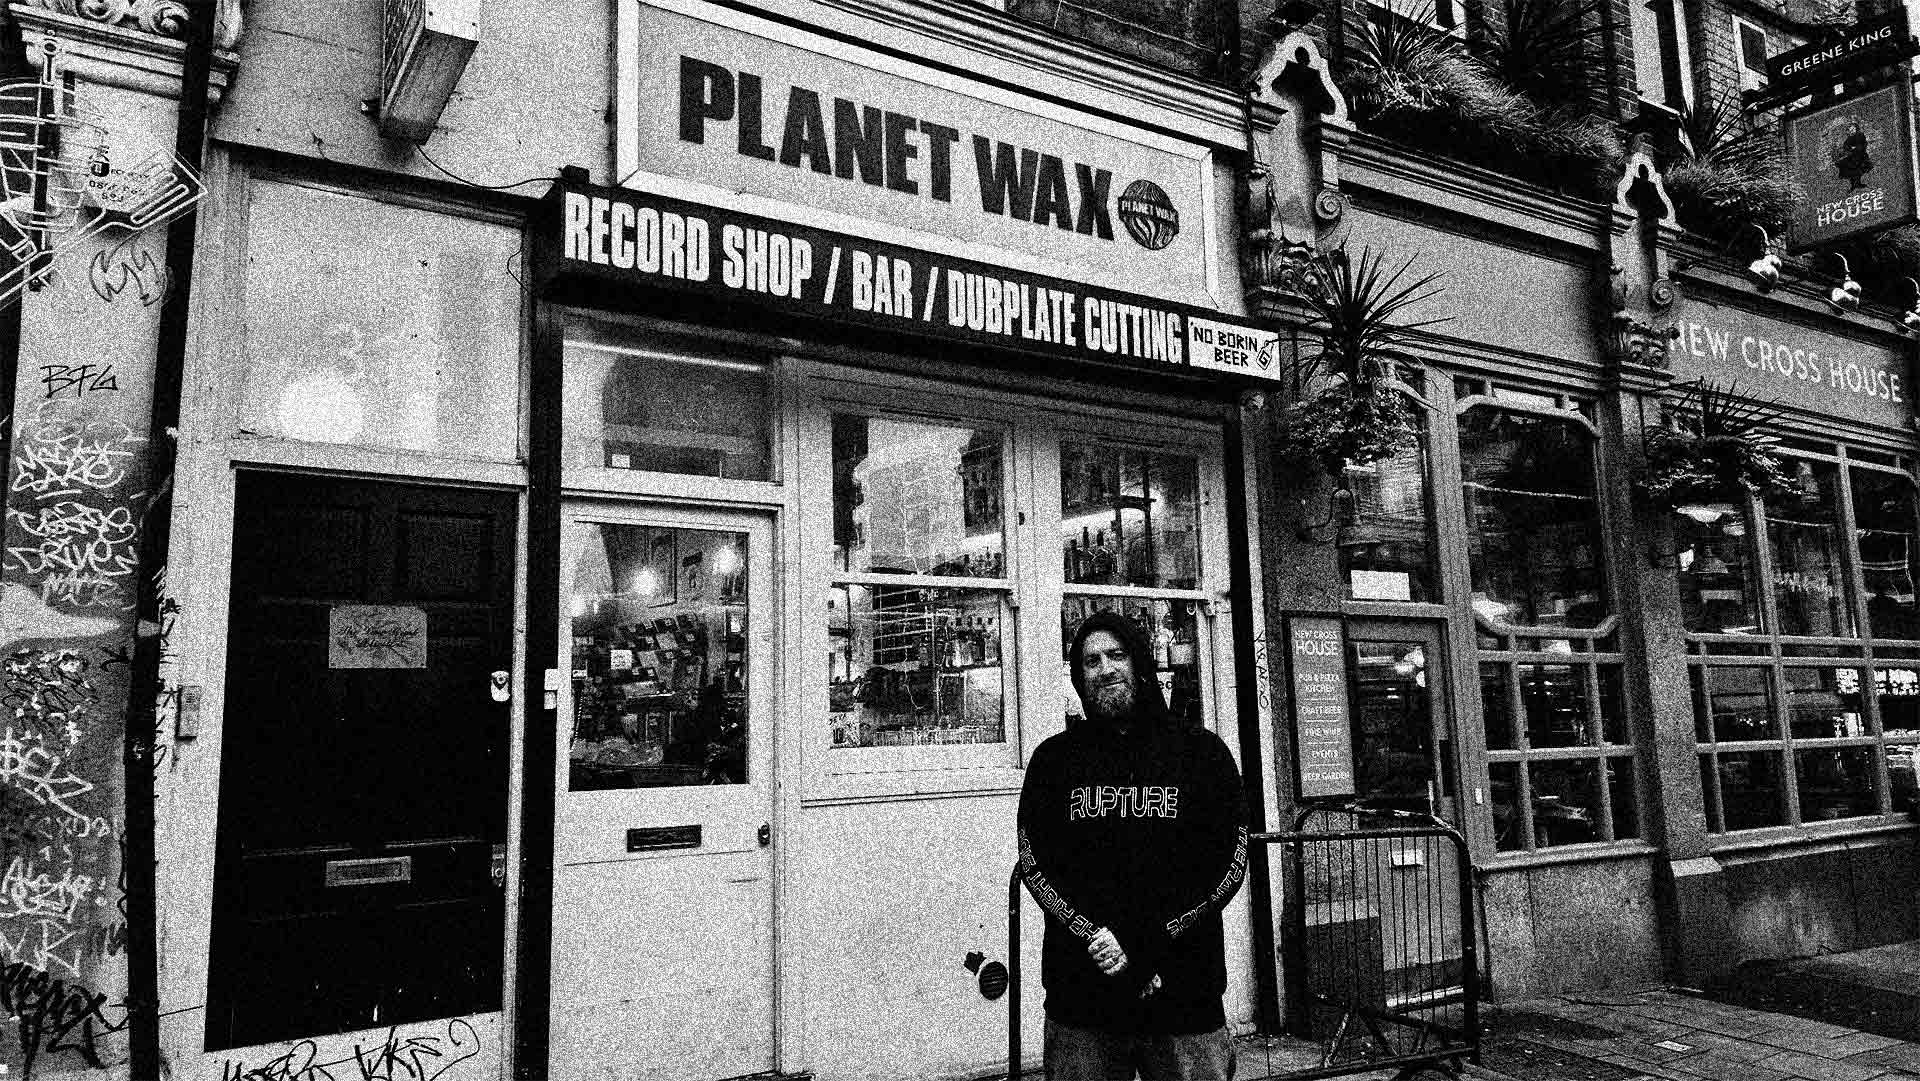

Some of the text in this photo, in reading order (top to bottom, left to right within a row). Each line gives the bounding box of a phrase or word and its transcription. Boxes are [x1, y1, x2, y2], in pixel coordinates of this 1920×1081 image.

[1781, 26, 1892, 76] GREENE KING
[679, 55, 1115, 241] PLANET WAX
[1121, 200, 1154, 216] PLANET
[1816, 188, 1885, 214] NEW CROSS
[1816, 200, 1885, 227] HOUSE
[564, 191, 710, 282] RECORD
[722, 223, 813, 300] SHOP
[852, 249, 913, 319] BAR
[947, 269, 1077, 347] DUBPLATE
[1084, 297, 1183, 365] CUTTING
[1193, 326, 1213, 344] NO
[1214, 347, 1249, 367] BEER
[1669, 319, 1902, 403] NEW CROSS HOUSE
[1294, 629, 1338, 639] NEW CROSS
[1295, 640, 1339, 656] HOUSE
[1070, 786, 1178, 820] RUPTURE
[1026, 871, 1075, 924] RIGHT
[1069, 914, 1102, 941] HE
